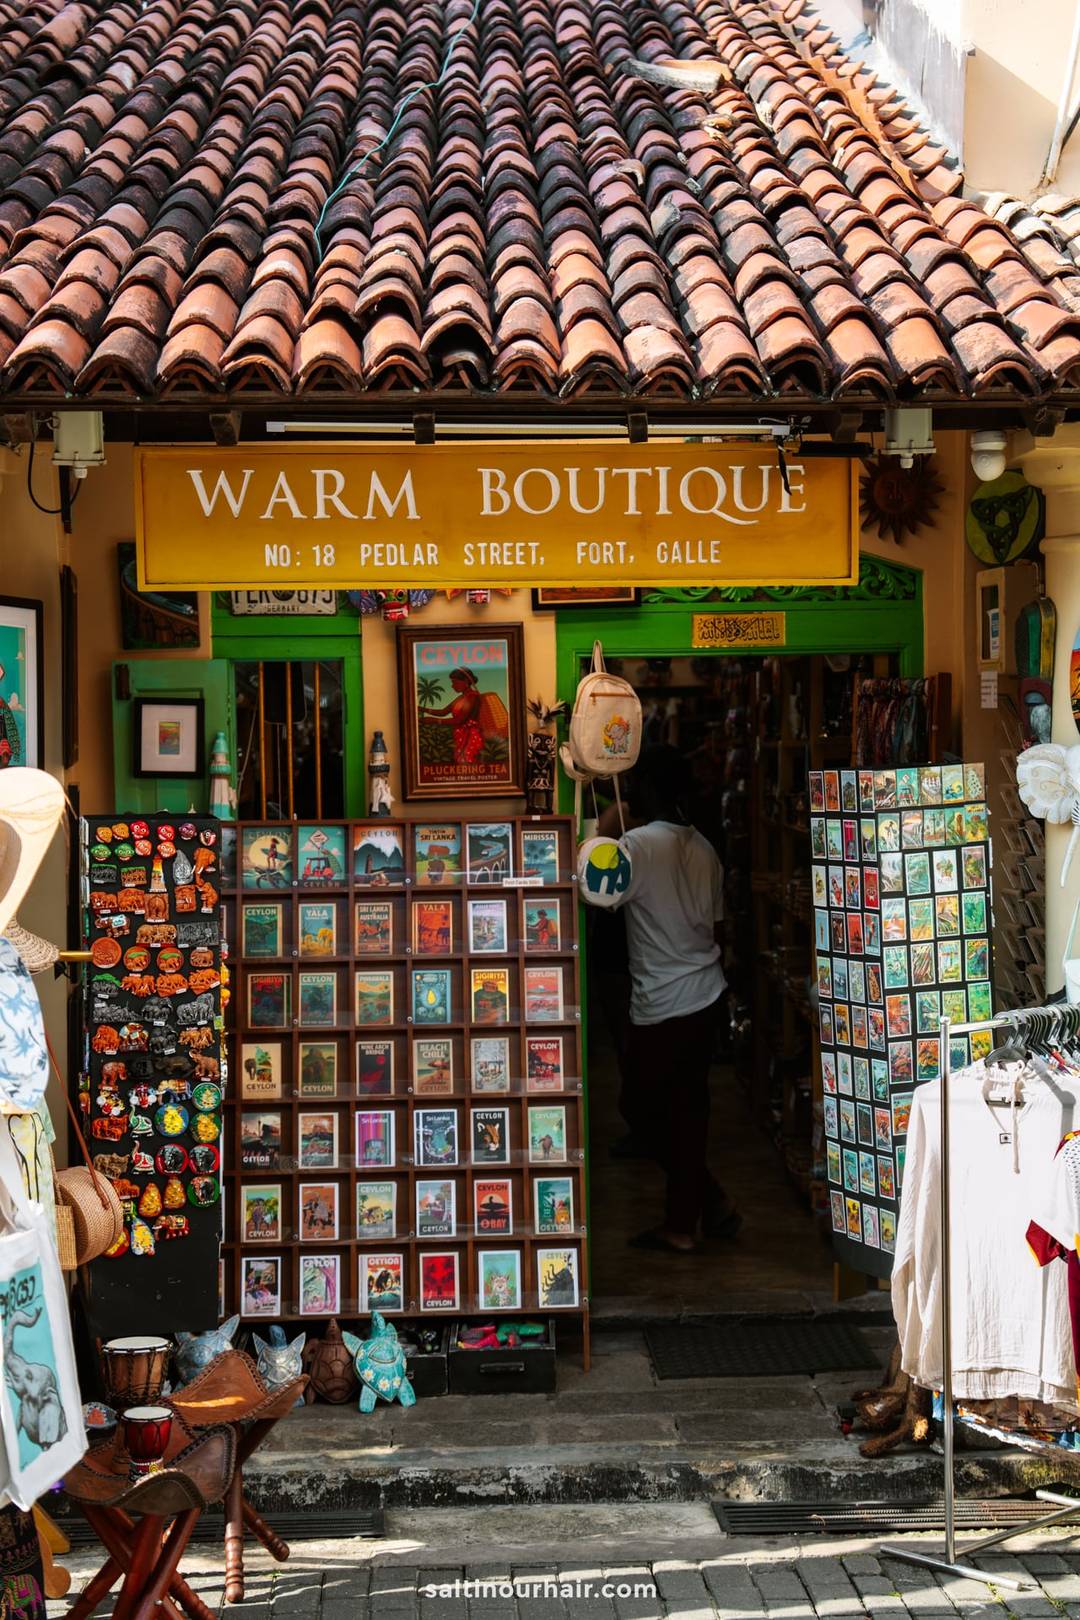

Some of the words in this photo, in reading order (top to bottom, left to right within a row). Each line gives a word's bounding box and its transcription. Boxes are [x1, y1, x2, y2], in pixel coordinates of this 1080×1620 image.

[186, 469, 421, 519] WARM
[477, 465, 807, 526] BOUTIQUE
[264, 543, 301, 567] NO:
[312, 543, 336, 567] 18
[360, 543, 440, 566] PEDLAR
[463, 542, 546, 566] STREET,
[576, 541, 635, 564] FORT,
[657, 540, 721, 564] GALLE
[421, 645, 504, 665] CEYLON
[423, 764, 485, 776] PLUCKERING
[490, 763, 507, 774] TEA
[246, 908, 277, 916] CEYLON
[423, 904, 446, 912] YALA
[306, 909, 328, 917] YALA
[419, 1043, 448, 1052] BEACH
[476, 1112, 503, 1120] CEYLON
[477, 1184, 508, 1192] CEYLON
[422, 1225, 449, 1233] CEYLON
[248, 1230, 276, 1238] CEYLON
